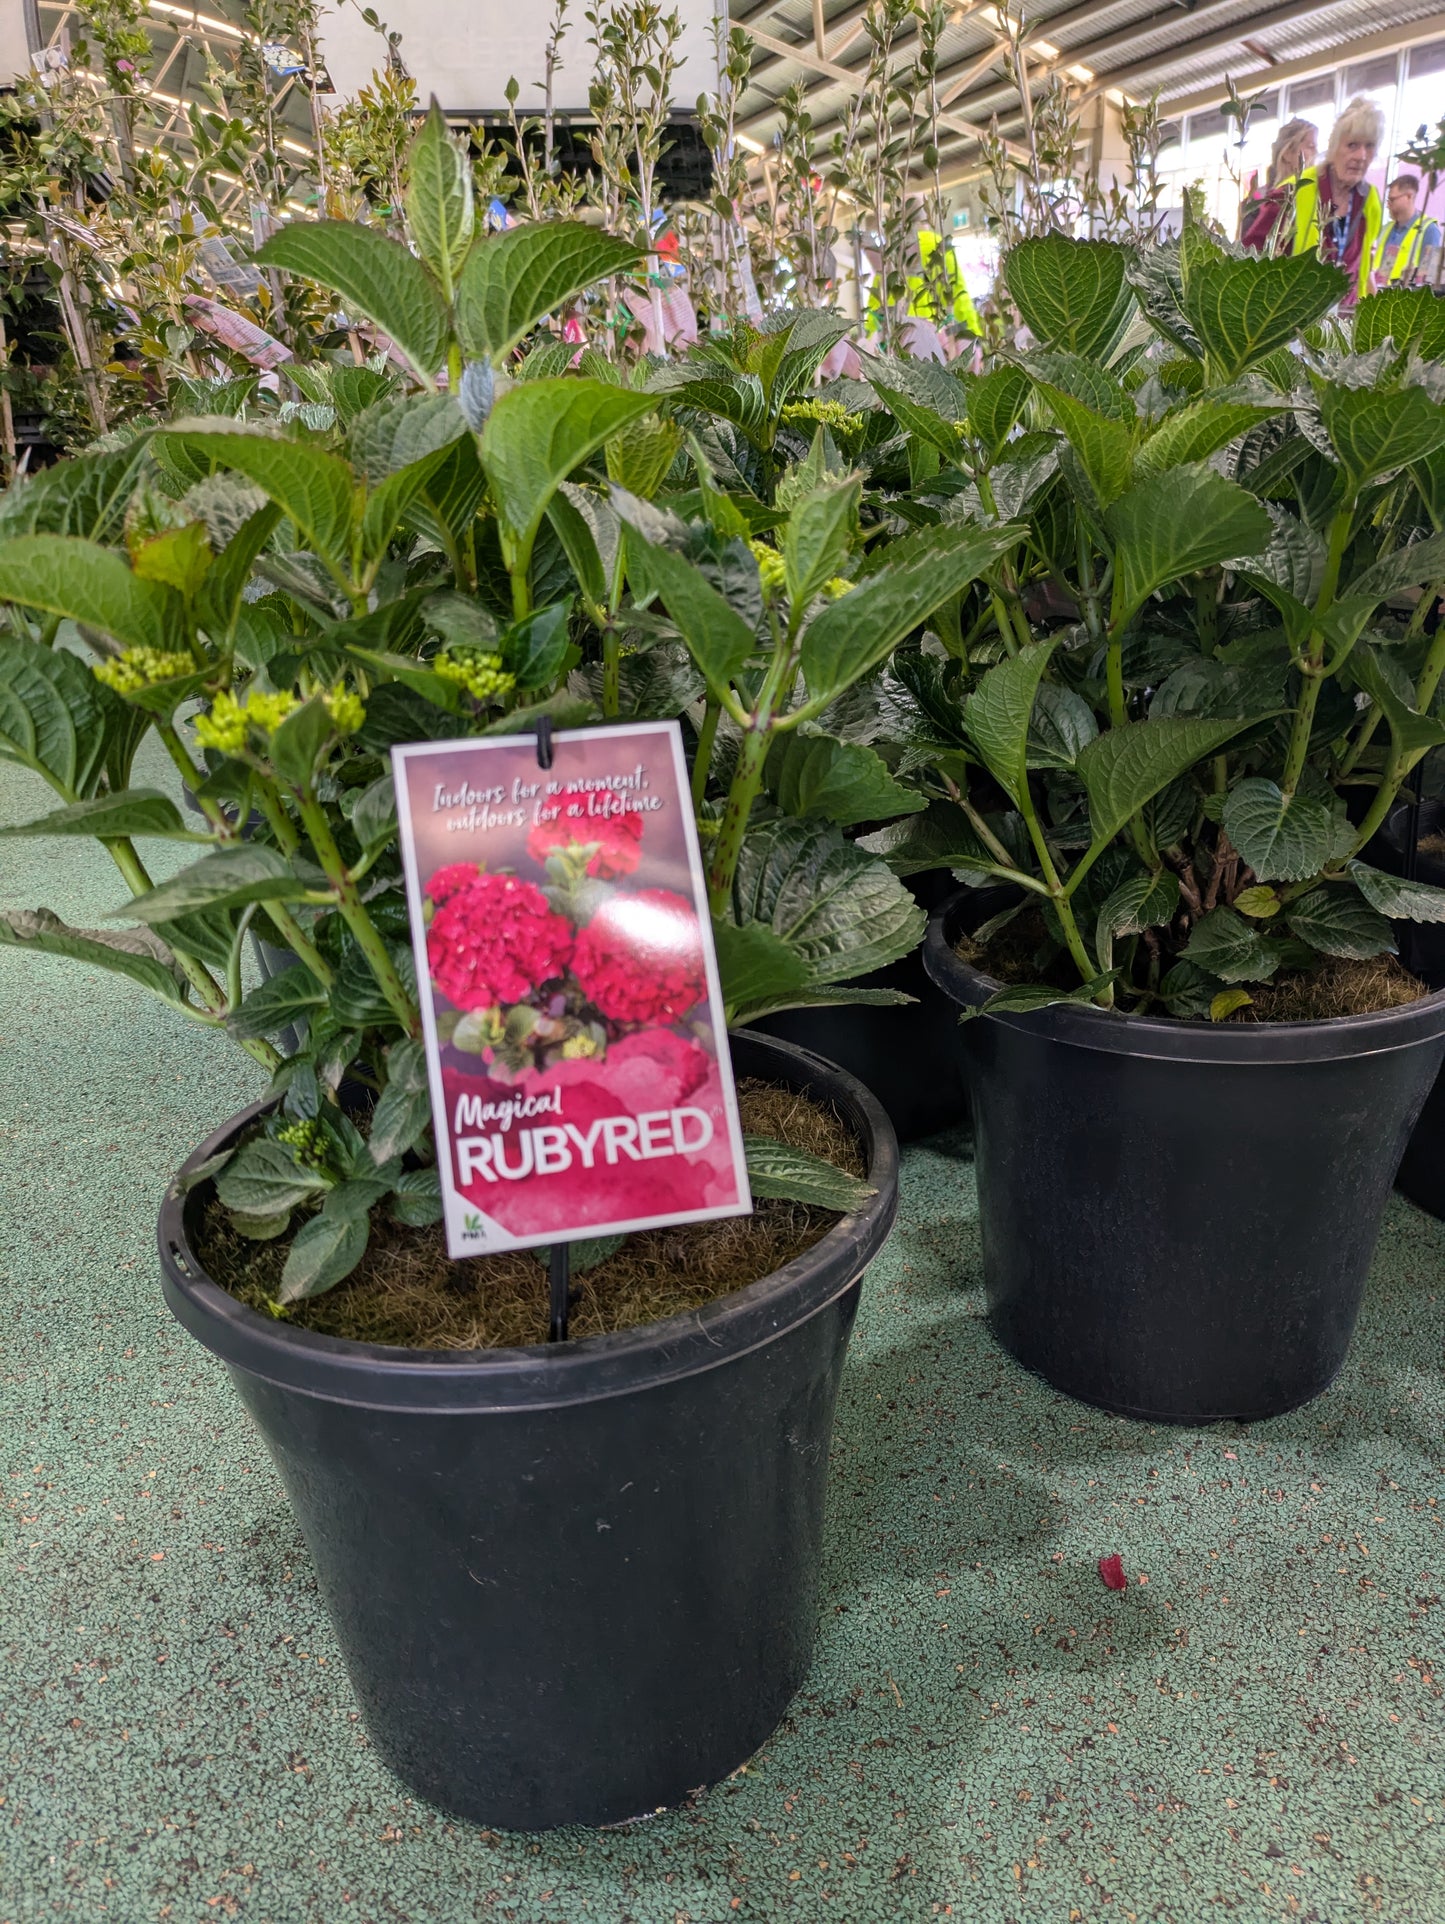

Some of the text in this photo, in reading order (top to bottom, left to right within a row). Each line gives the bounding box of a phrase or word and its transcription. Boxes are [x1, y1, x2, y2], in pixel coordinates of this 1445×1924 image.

[432, 781, 507, 812] Indoors
[511, 776, 541, 805] for
[546, 780, 563, 795] a
[446, 790, 664, 833] outdoors for a lifetime
[454, 1085, 564, 1135] Magical
[455, 1106, 714, 1186] RUBYRED
